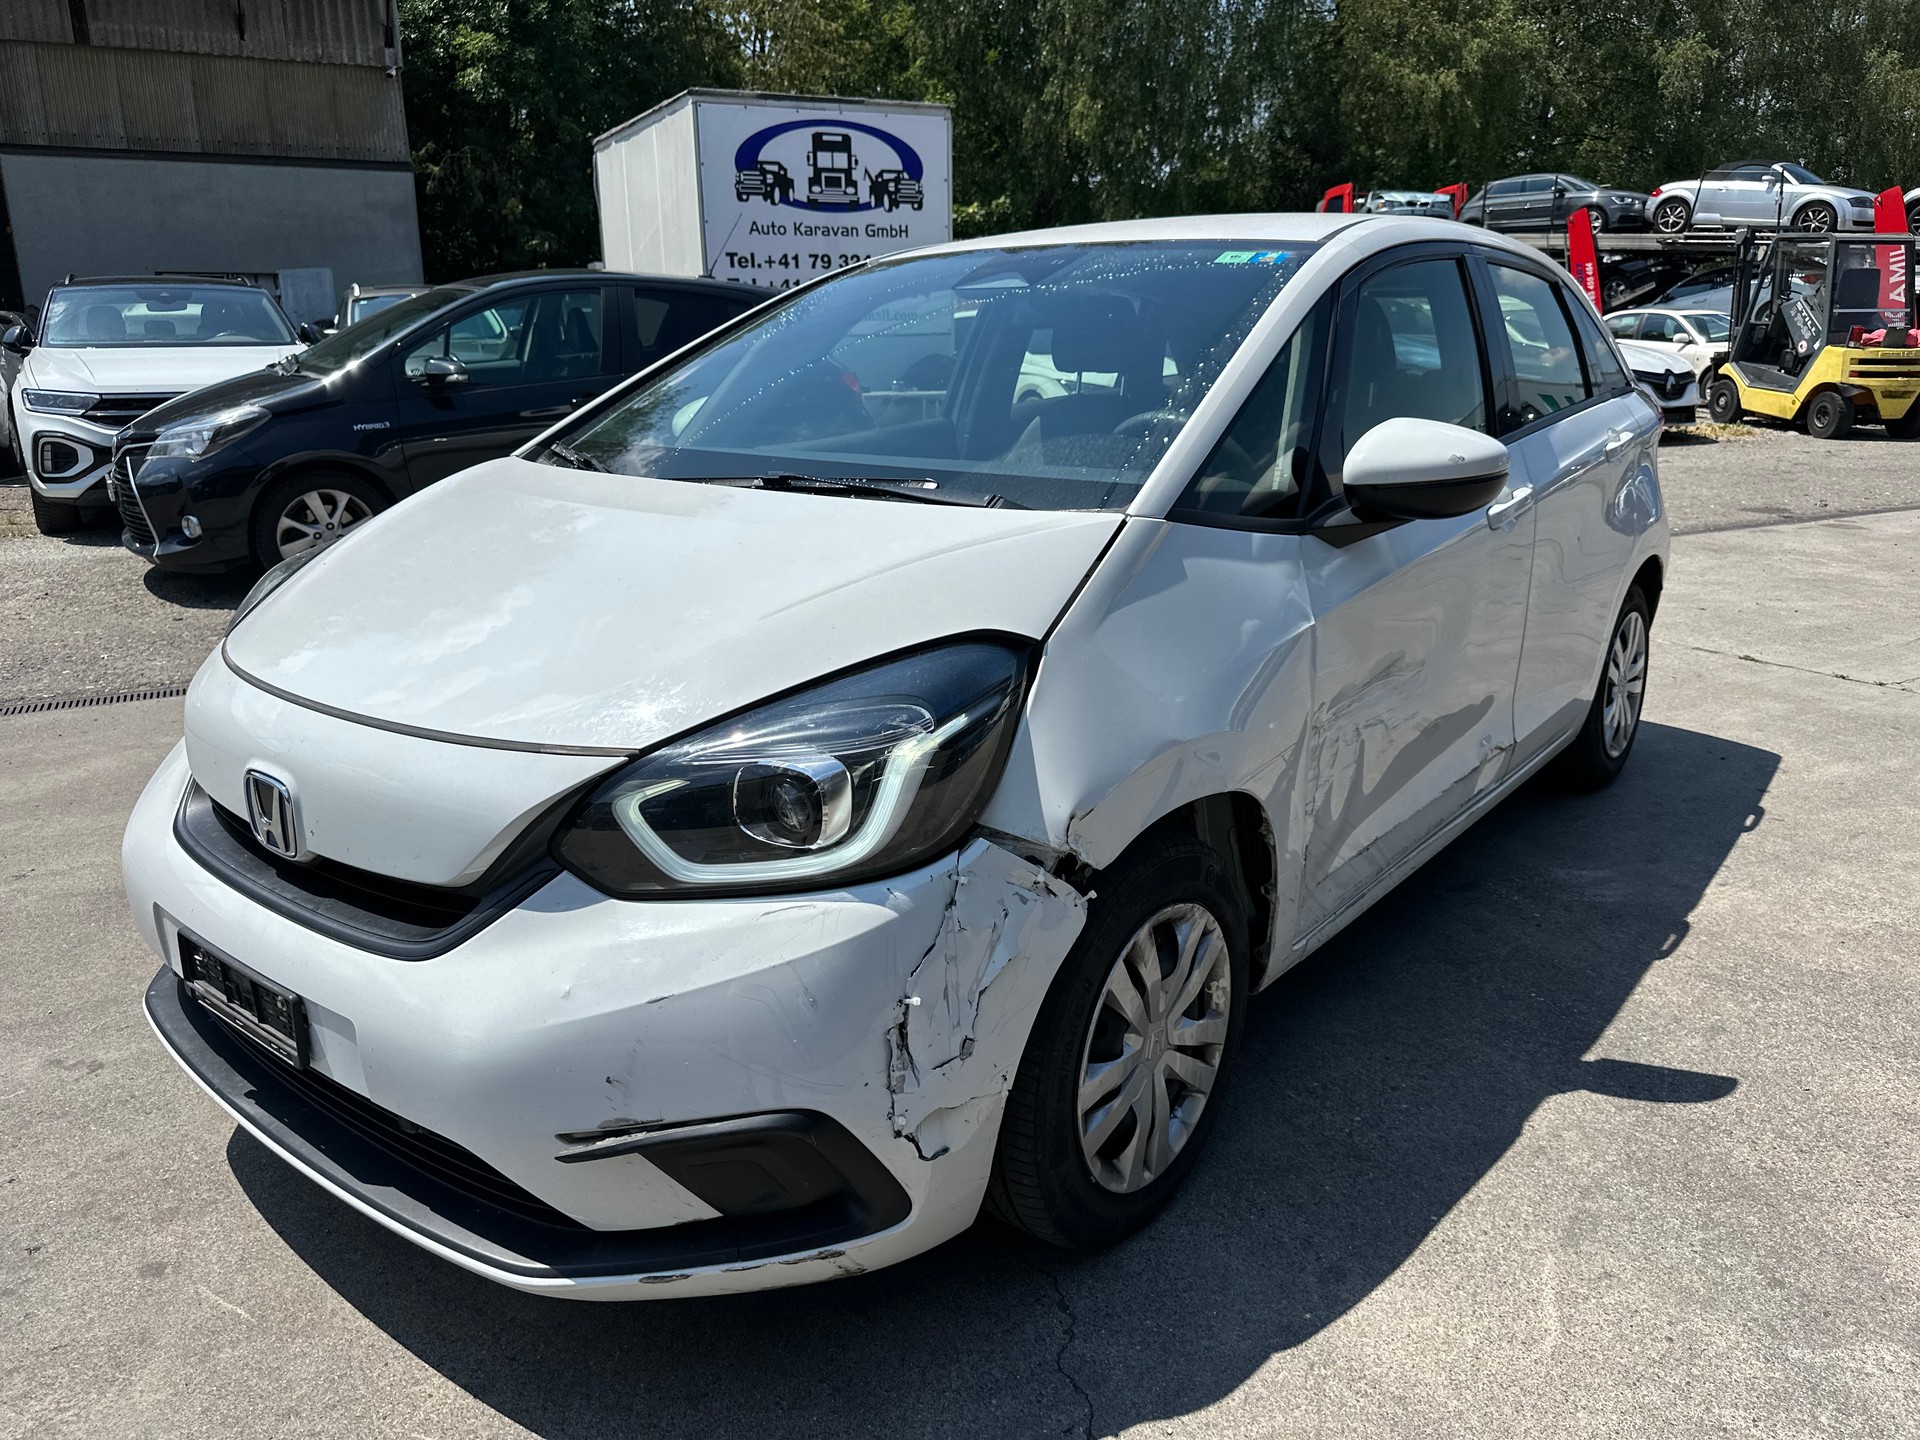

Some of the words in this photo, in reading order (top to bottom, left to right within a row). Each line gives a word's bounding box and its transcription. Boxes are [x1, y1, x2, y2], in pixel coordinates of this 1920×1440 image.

[749, 221, 787, 236] Auto
[794, 222, 859, 238] Karavan
[865, 224, 909, 239] GmbH
[726, 252, 800, 269] Tel.+41
[809, 253, 832, 269] 79
[863, 308, 919, 321] mail.com
